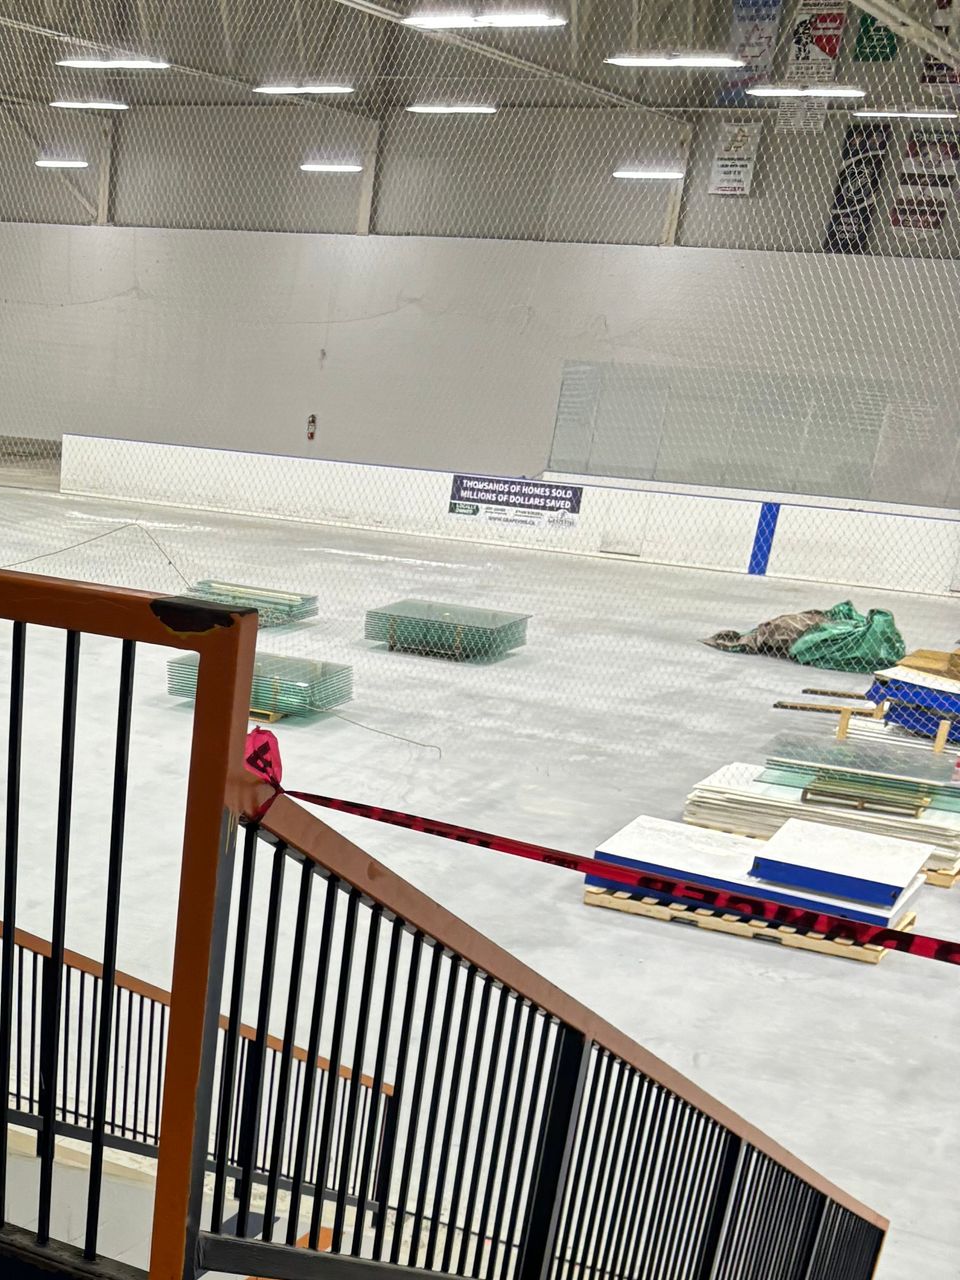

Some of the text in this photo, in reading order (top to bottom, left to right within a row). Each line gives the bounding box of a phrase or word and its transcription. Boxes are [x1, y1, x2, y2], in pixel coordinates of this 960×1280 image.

[462, 480, 572, 498] THOUSANDS OF HOMES SOLD
[460, 490, 571, 509] MILLIONS OF DOLLARS SAVED
